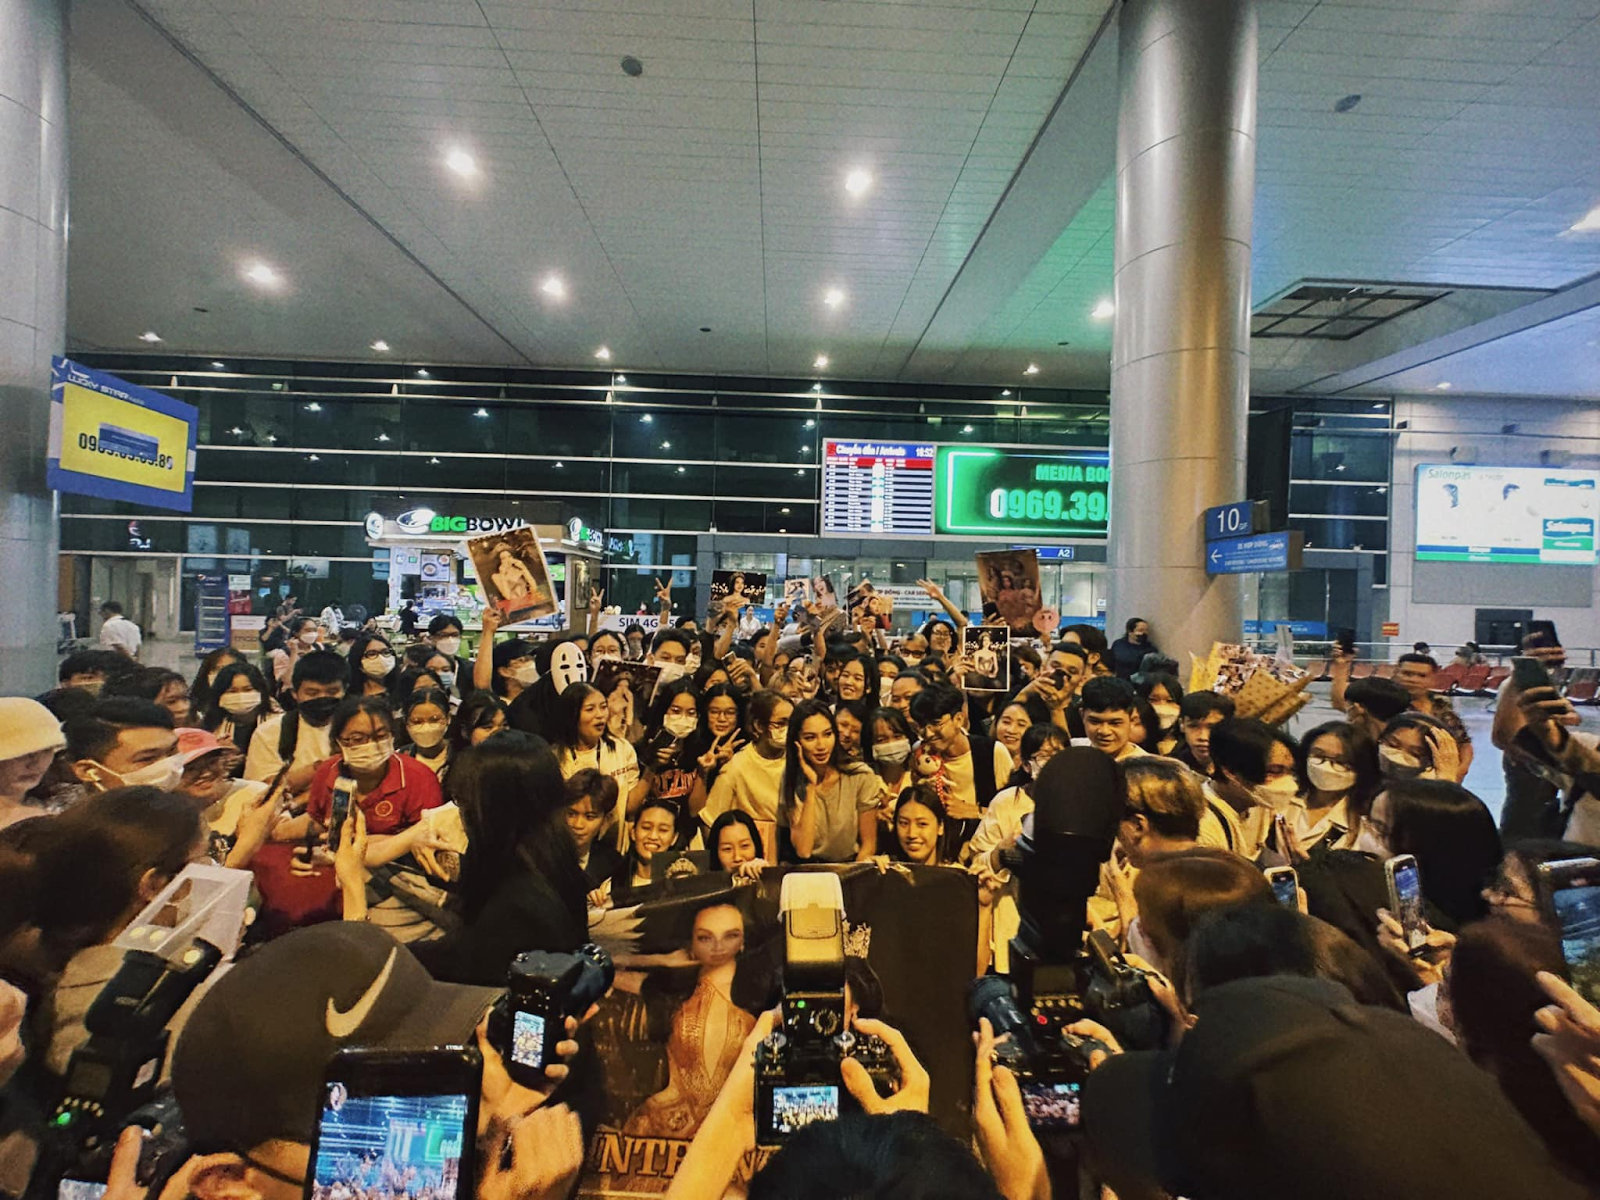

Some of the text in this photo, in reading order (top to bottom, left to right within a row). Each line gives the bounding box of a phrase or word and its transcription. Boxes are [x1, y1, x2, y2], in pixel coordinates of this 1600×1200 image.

[1036, 464, 1083, 481] MEDIA
[1217, 508, 1240, 532] 10
[1058, 549, 1071, 558] A2
[619, 617, 640, 628] SIM
[643, 618, 658, 628] 4G
